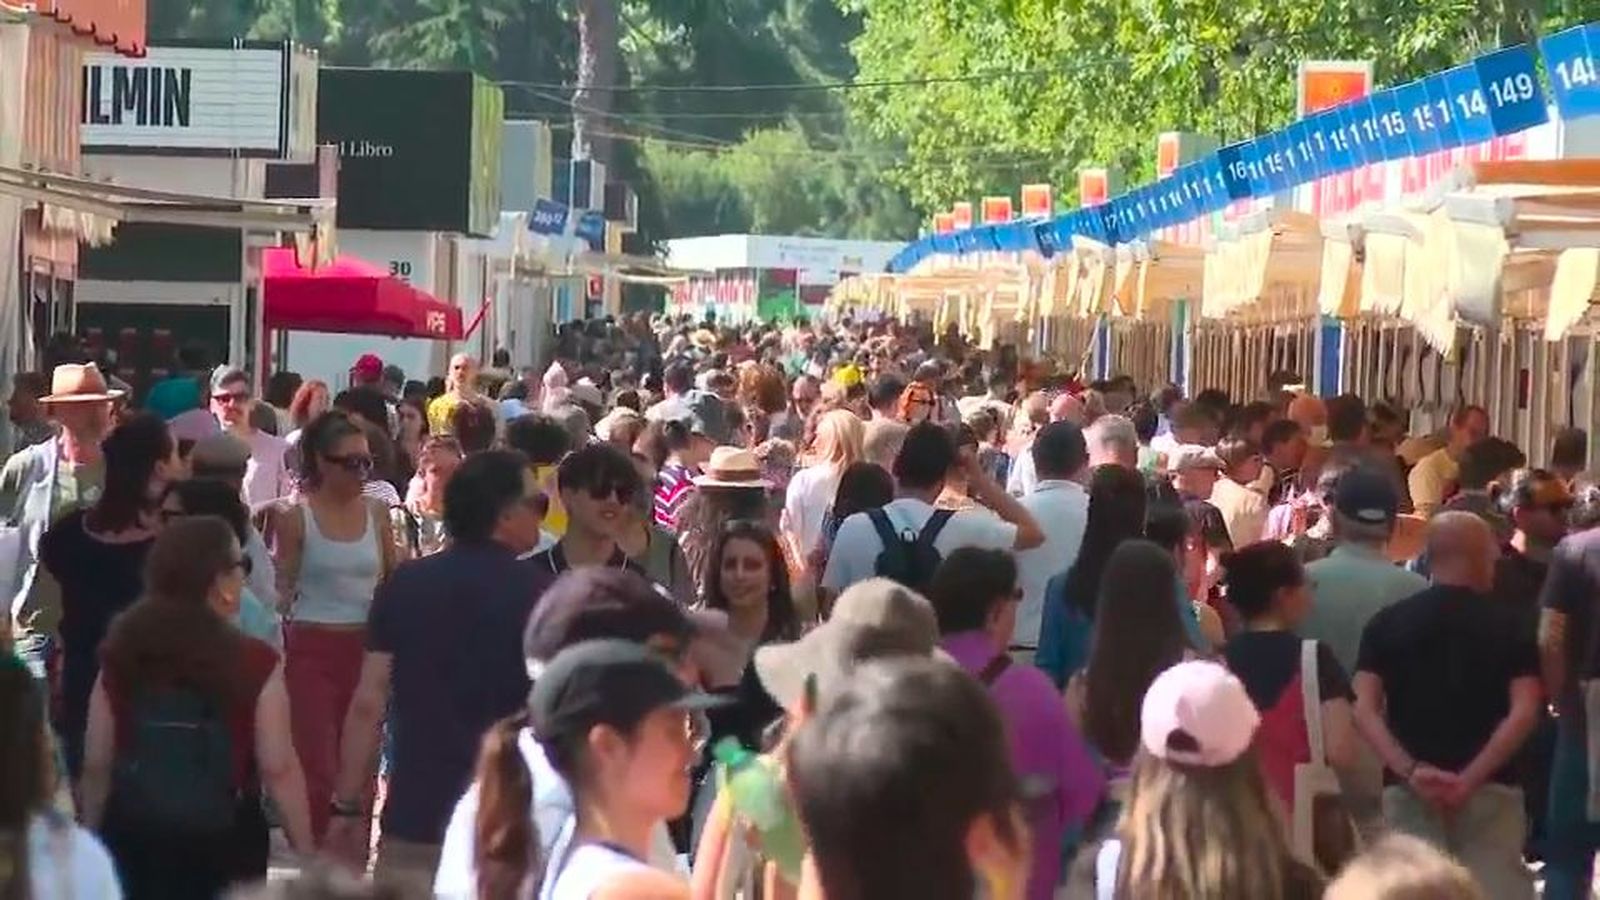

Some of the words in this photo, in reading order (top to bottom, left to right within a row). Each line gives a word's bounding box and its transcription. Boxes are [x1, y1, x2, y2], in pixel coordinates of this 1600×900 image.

[1490, 72, 1533, 108] 149
[1456, 89, 1487, 119] 14
[1381, 111, 1406, 137] 15
[350, 140, 393, 157] Libro
[1228, 161, 1247, 181] 16
[389, 261, 411, 276] 30
